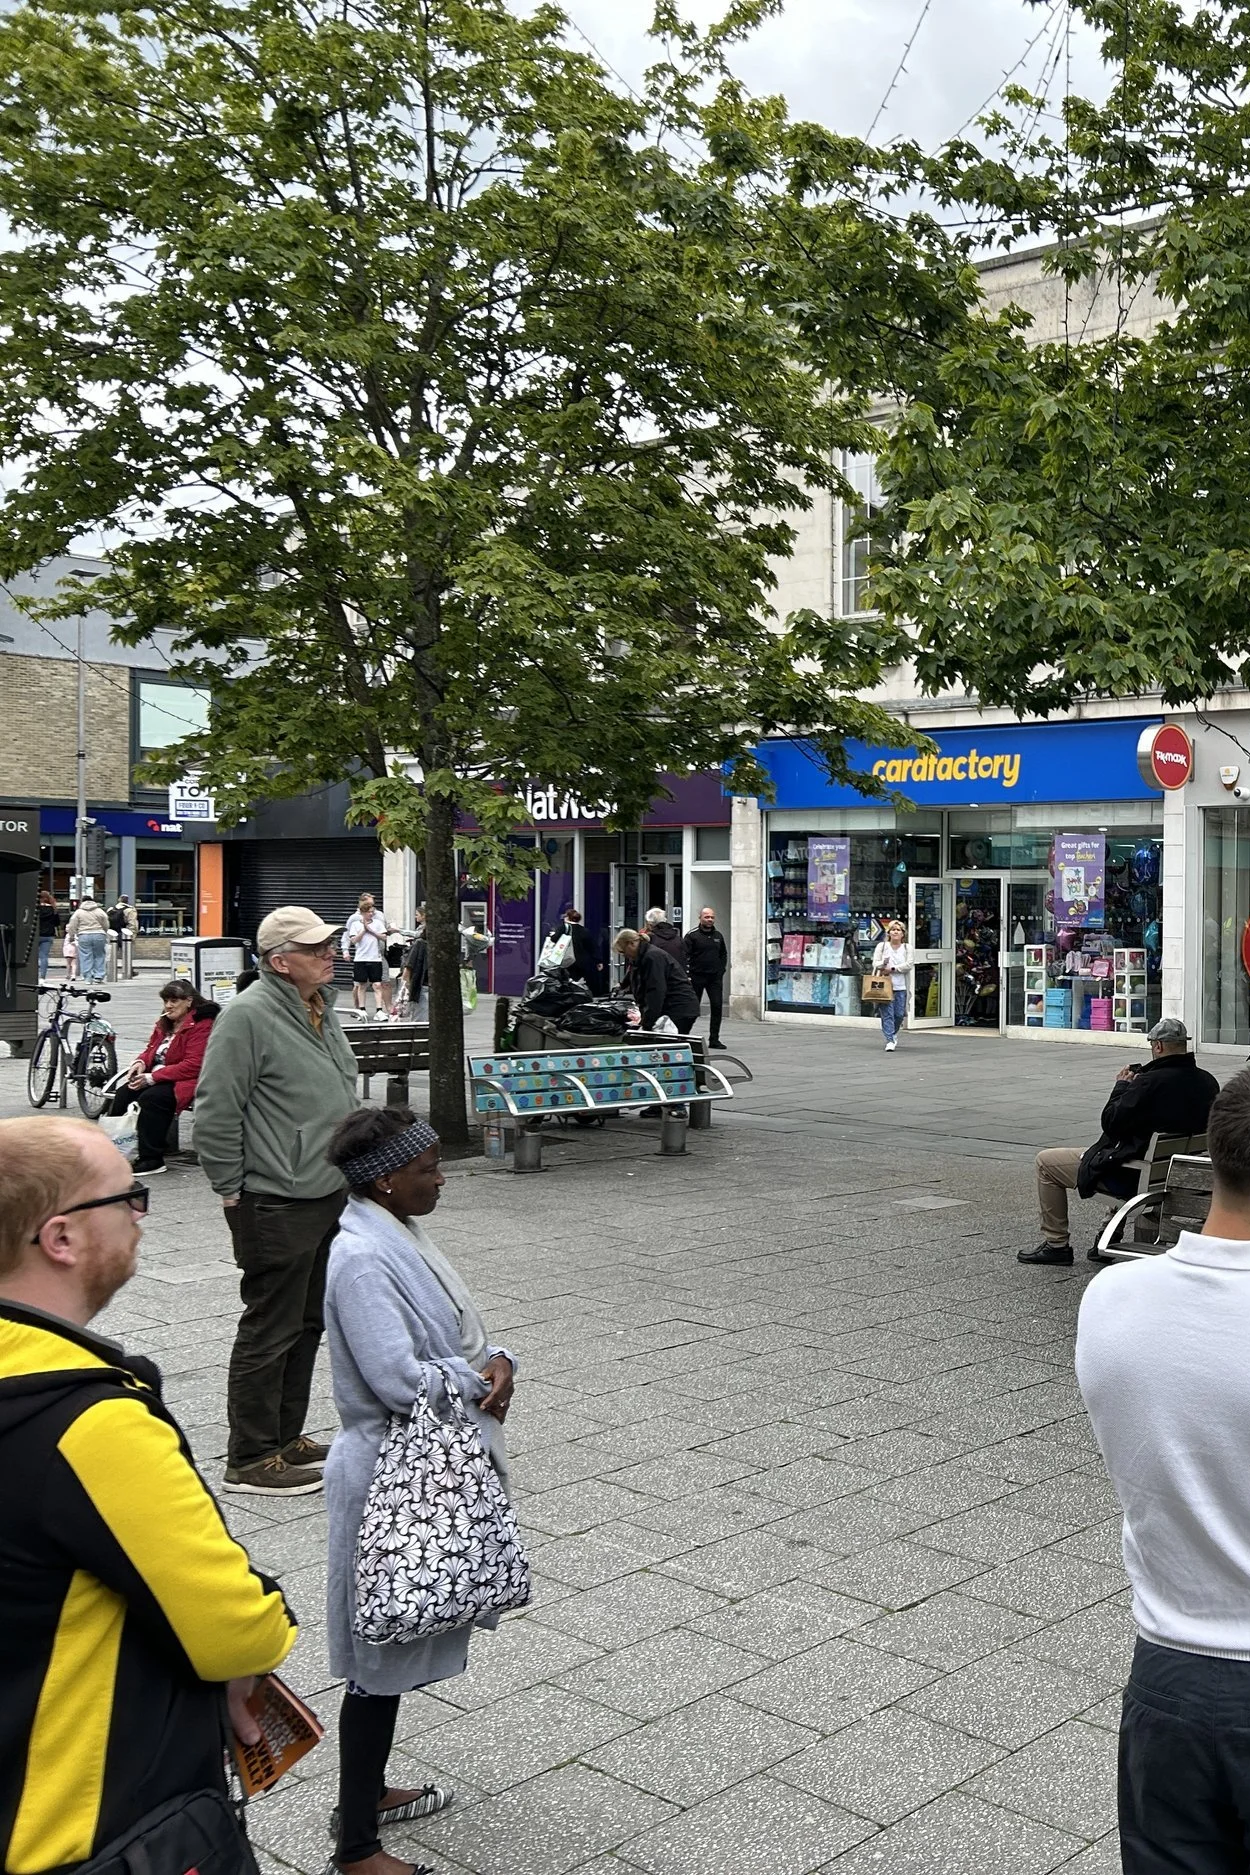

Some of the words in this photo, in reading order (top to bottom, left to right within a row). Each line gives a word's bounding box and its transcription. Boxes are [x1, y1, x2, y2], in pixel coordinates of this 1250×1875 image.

[872, 748, 1021, 788] cardfactory
[0, 820, 29, 832] TOR
[160, 823, 183, 832] nat
[254, 1739, 276, 1779] AVEN
